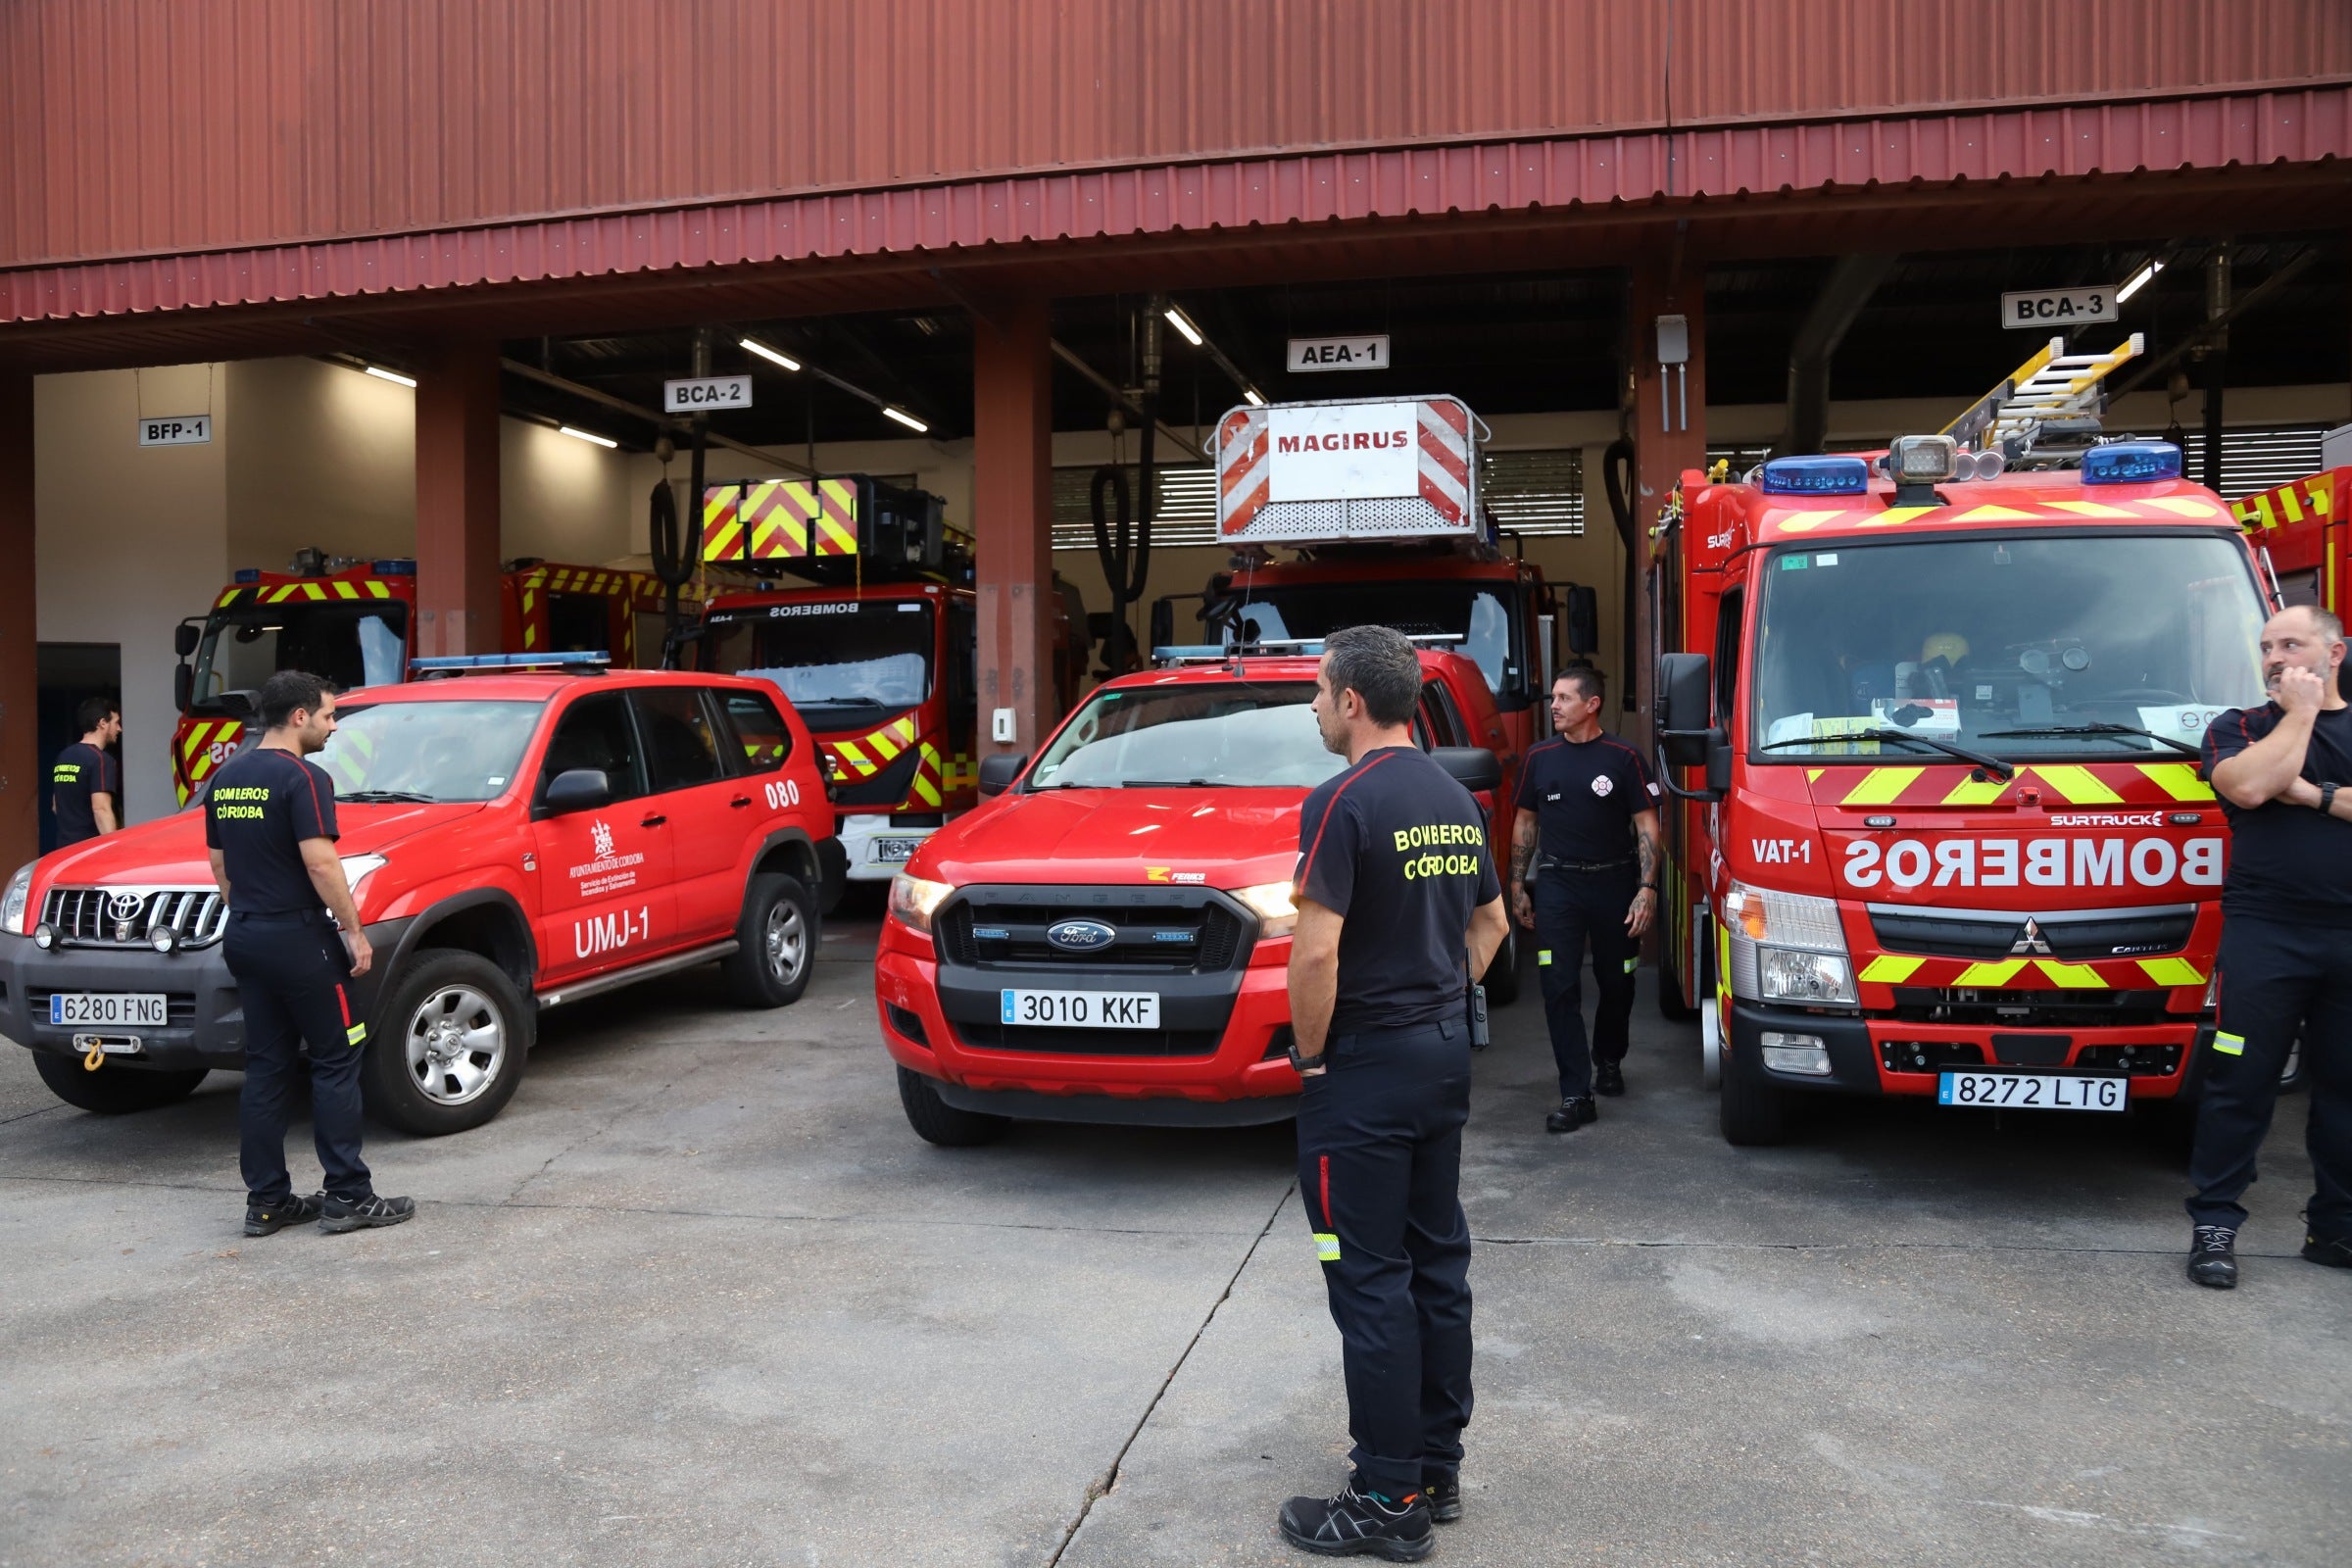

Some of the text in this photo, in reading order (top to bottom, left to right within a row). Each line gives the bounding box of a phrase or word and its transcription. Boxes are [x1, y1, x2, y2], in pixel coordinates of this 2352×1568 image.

[1301, 342, 1377, 365] AEA-1
[1278, 430, 1408, 453] MAGIRUS
[214, 787, 270, 802] BOMBEROS
[764, 779, 800, 809] 080
[1394, 824, 1483, 852] BOMBEROS
[1752, 838, 1811, 864] VAT-1
[1404, 852, 1478, 880] CÓRDOBA
[574, 906, 649, 958] UMJ-1
[1060, 926, 1098, 944] Ford
[65, 998, 117, 1020] 6280
[123, 998, 163, 1021] FNG
[1023, 995, 1088, 1022] 3010
[1102, 997, 1152, 1024] KKF
[1959, 1076, 2041, 1104] 8272
[2054, 1079, 2117, 1107] LTG
